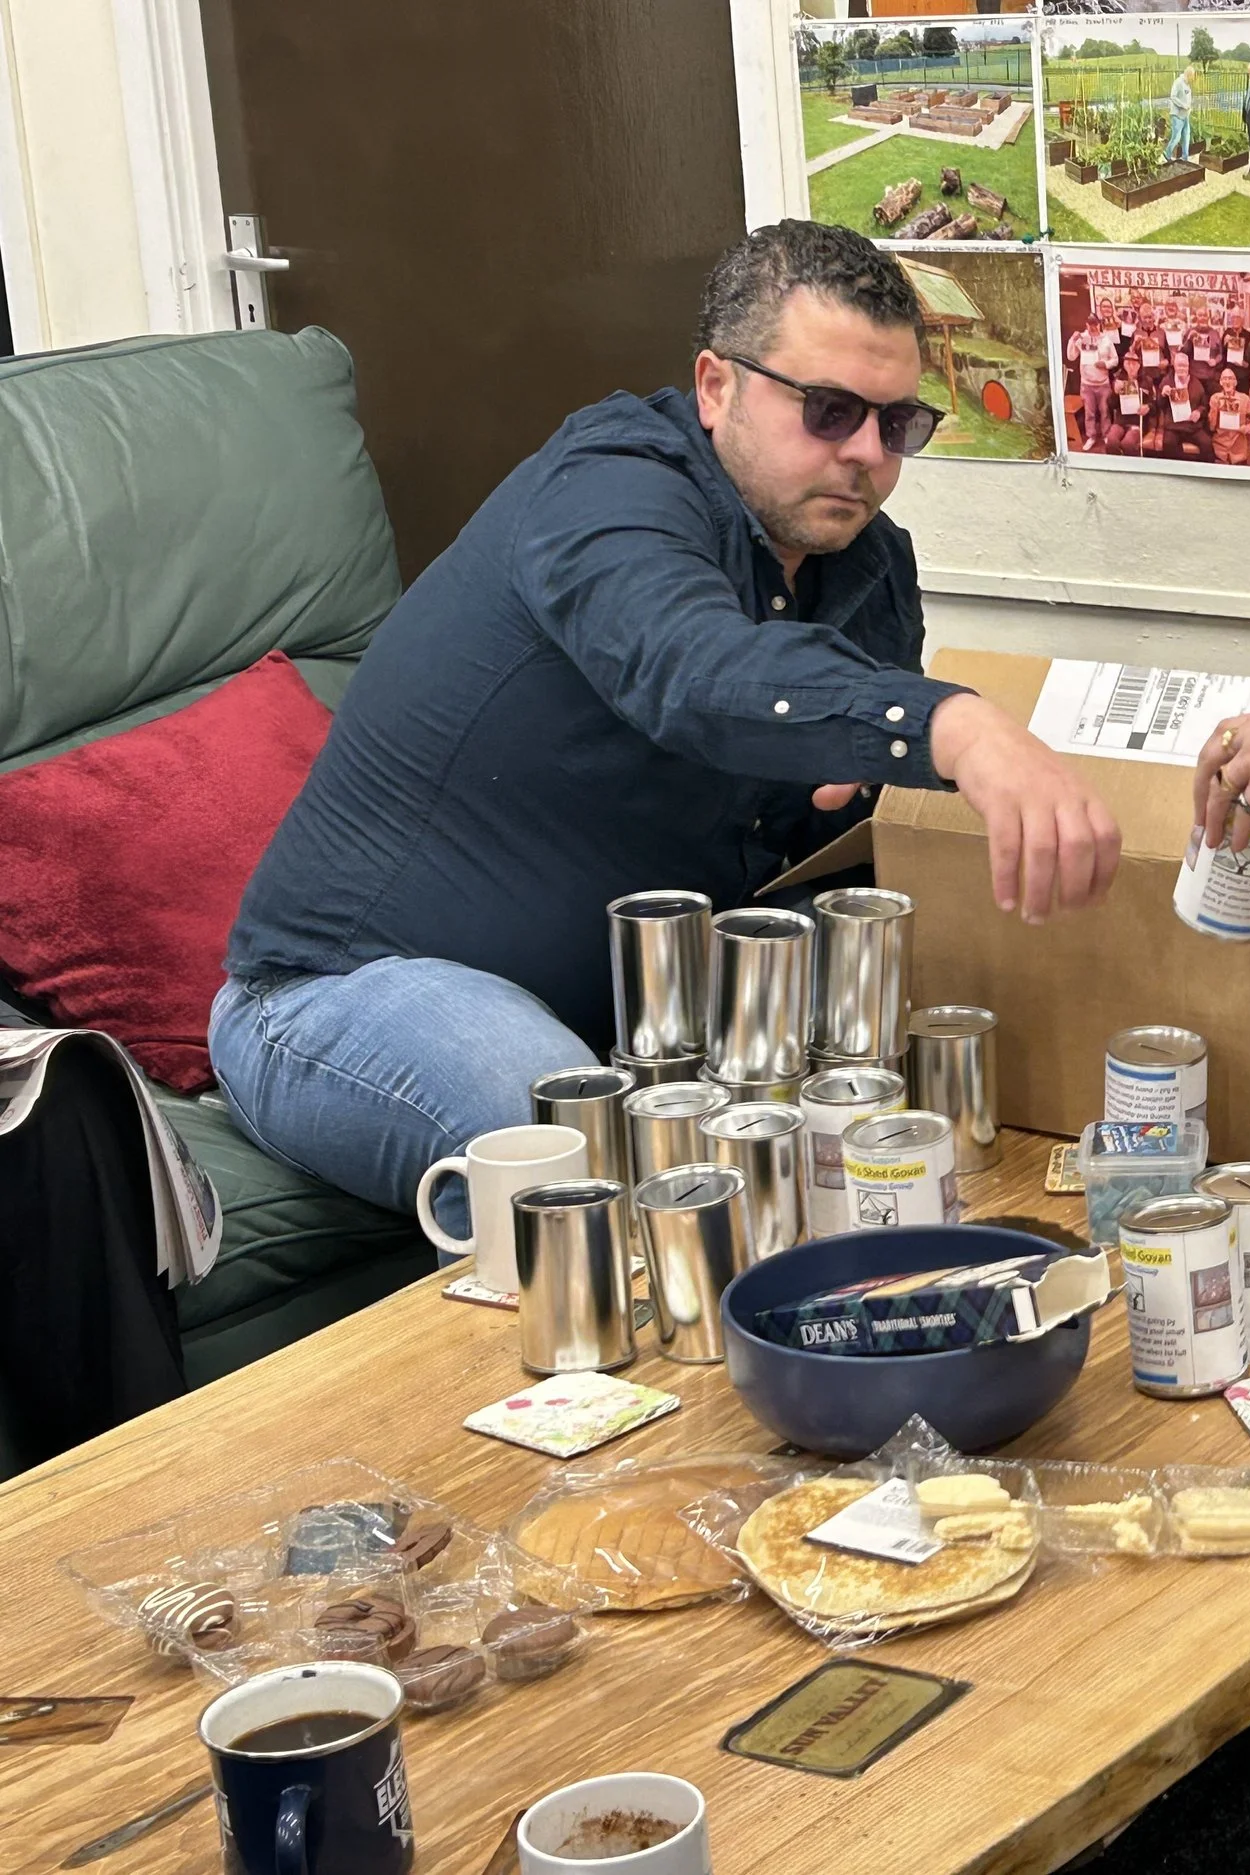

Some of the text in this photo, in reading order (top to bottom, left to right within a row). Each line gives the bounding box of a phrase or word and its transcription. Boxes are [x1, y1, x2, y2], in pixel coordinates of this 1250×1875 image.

[863, 1167, 888, 1178] Shed
[890, 1165, 927, 1178] Govan
[1137, 1249, 1172, 1263] Govan
[800, 1318, 859, 1346] DEAN'S
